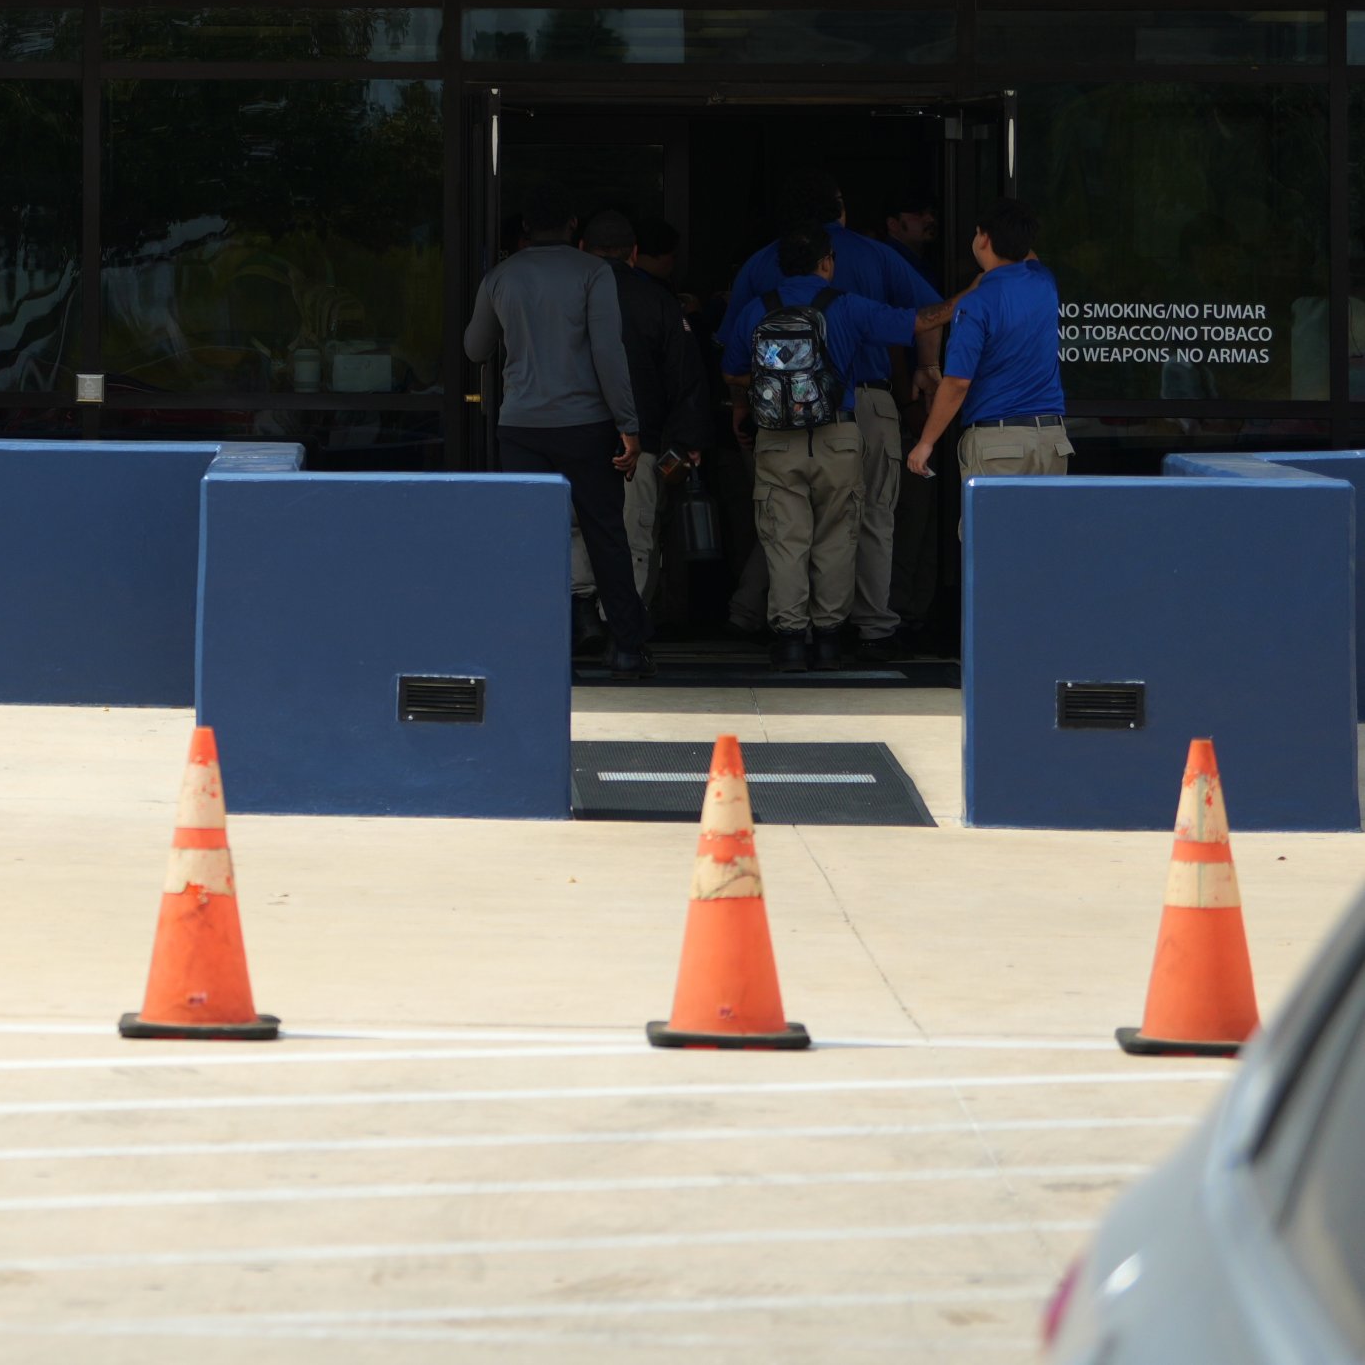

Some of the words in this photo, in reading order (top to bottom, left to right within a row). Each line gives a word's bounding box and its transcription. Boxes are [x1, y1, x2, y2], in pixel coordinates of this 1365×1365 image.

[1057, 303, 1080, 318] NO
[1083, 303, 1200, 319] SMOKING/NO
[1203, 304, 1266, 319] FUMAR
[1057, 325, 1080, 340] NO
[1081, 325, 1198, 341] TOBACCO/NO
[1200, 326, 1272, 342] TOBACO
[1057, 347, 1080, 362] NO
[1082, 347, 1170, 363] WEAPONS
[1176, 348, 1204, 363] NO
[1206, 348, 1270, 363] ARMAS
